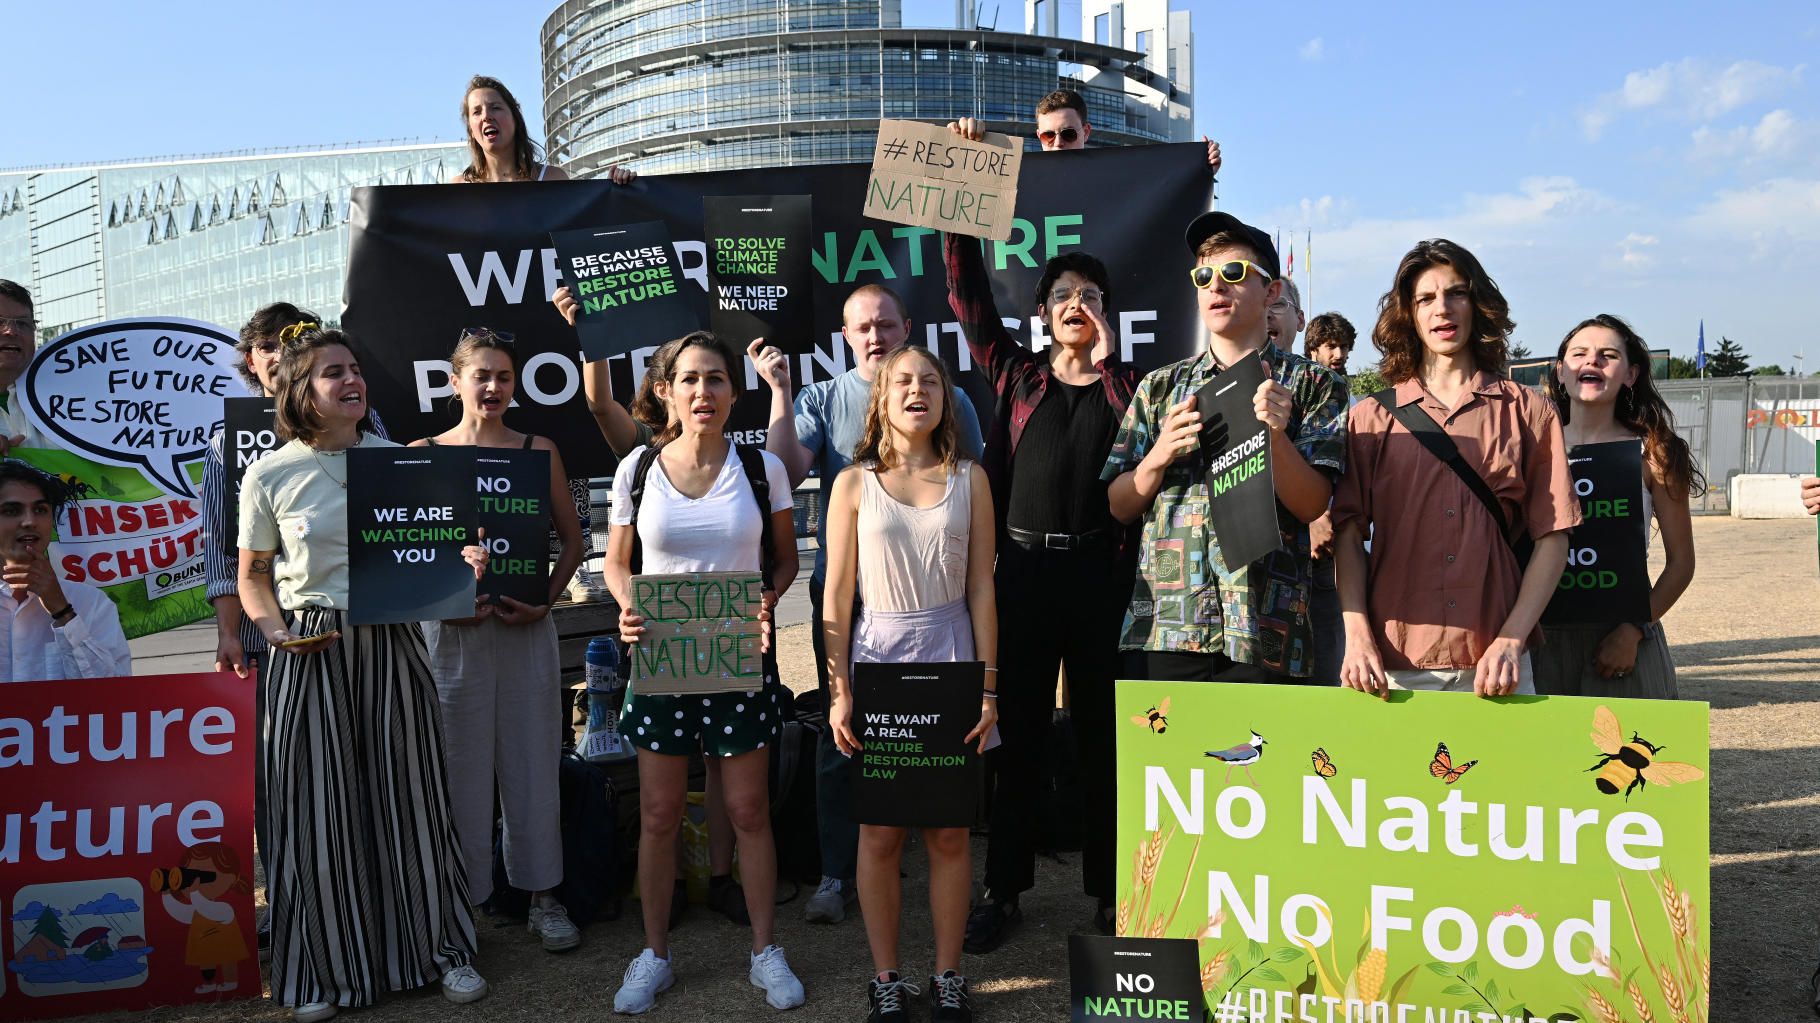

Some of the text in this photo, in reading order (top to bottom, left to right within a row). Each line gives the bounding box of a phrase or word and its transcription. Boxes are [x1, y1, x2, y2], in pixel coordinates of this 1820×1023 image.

[883, 138, 1015, 177] #RESTORE
[869, 178, 998, 227] NATURE
[715, 237, 786, 250] TO SOLVE
[571, 246, 665, 268] BECAUSE
[716, 250, 778, 262] CLIMATE
[574, 256, 668, 279] WE HAVE TO
[716, 262, 777, 274] CHANGE
[577, 266, 673, 296] RESTORE
[717, 285, 788, 298] WE NEED
[582, 280, 678, 315] NATURE
[719, 298, 778, 311] NATURE
[54, 335, 218, 374] SAVE OUR
[108, 368, 233, 396] FUTURE
[49, 394, 173, 427] RESTORE
[236, 429, 277, 449] DO
[1211, 429, 1266, 475] #RESTORE
[476, 476, 511, 493] NO
[1213, 450, 1266, 498] NATURE
[373, 506, 454, 523] WE ARE
[479, 496, 540, 515] TURE
[67, 499, 200, 537] INSEK
[361, 527, 467, 543] WATCHING
[61, 526, 206, 583] SCHÜT
[392, 548, 436, 564] YOU
[1559, 570, 1618, 590] OOD
[635, 579, 763, 625] RESTORE
[634, 633, 762, 679] NATURE
[865, 713, 941, 725] WE WANT
[863, 726, 917, 738] A REAL
[864, 740, 924, 753] NATURE
[863, 754, 966, 767] RESTORATION
[863, 767, 897, 780] LAW
[1144, 765, 1664, 871] No Nature
[1207, 870, 1611, 978] No Food
[1115, 972, 1155, 993] NO
[1084, 996, 1190, 1020] NATURE
